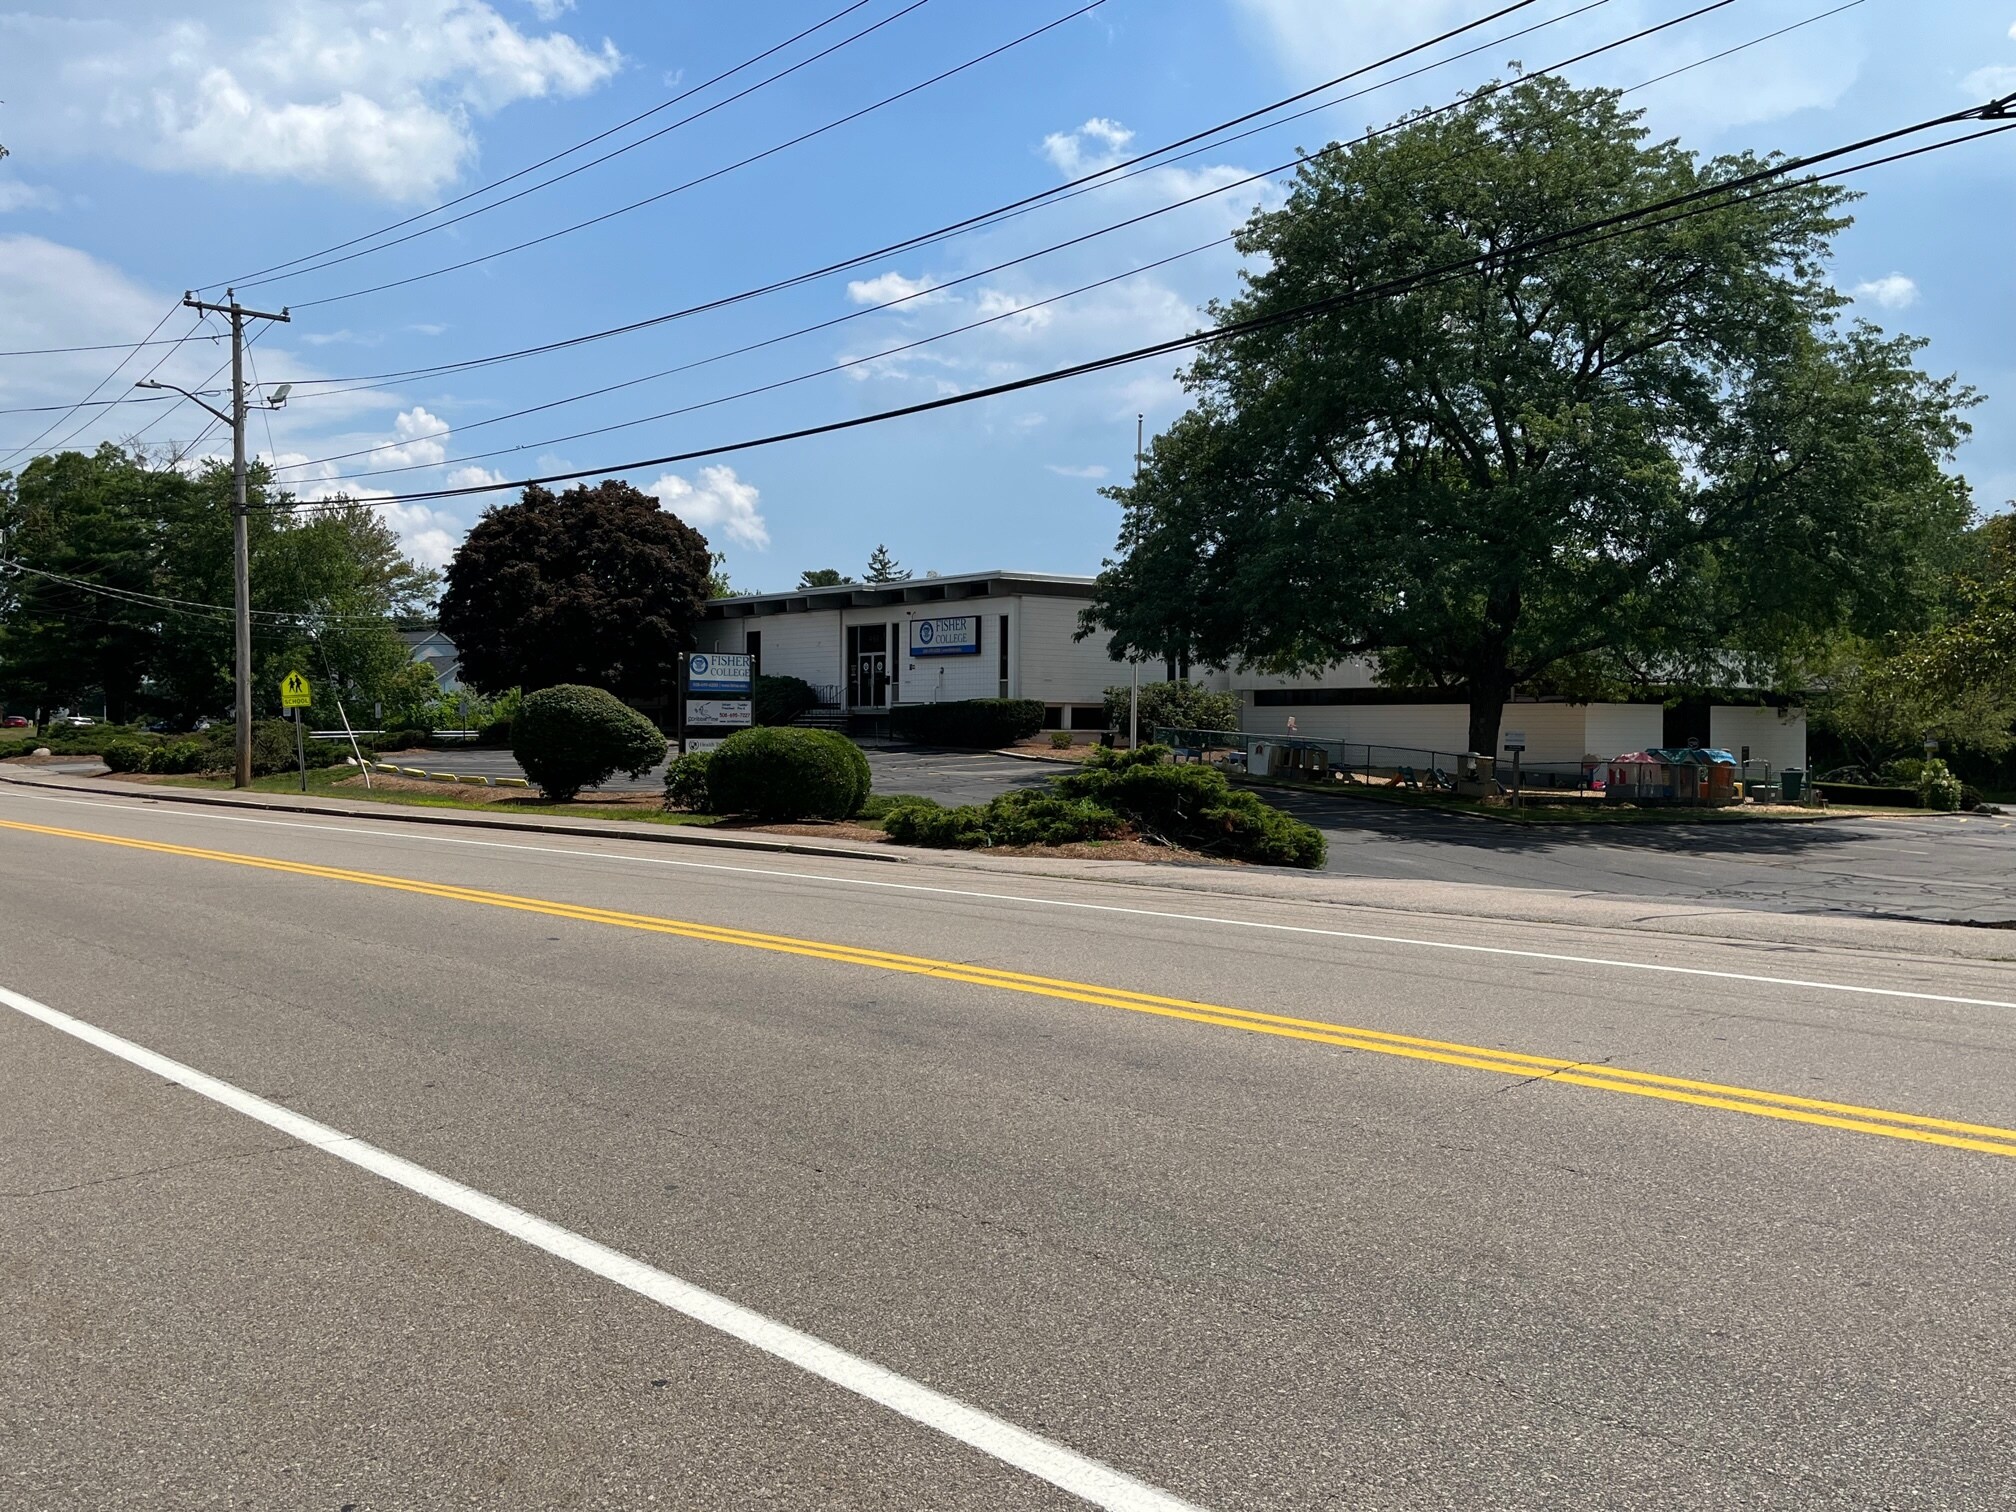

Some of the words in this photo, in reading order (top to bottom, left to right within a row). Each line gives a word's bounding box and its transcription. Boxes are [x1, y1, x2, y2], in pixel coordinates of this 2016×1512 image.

[935, 618, 967, 632] FISHER
[935, 633, 968, 644] COLLEGE
[711, 655, 750, 667] FISHER
[710, 668, 750, 677] COLLEGE
